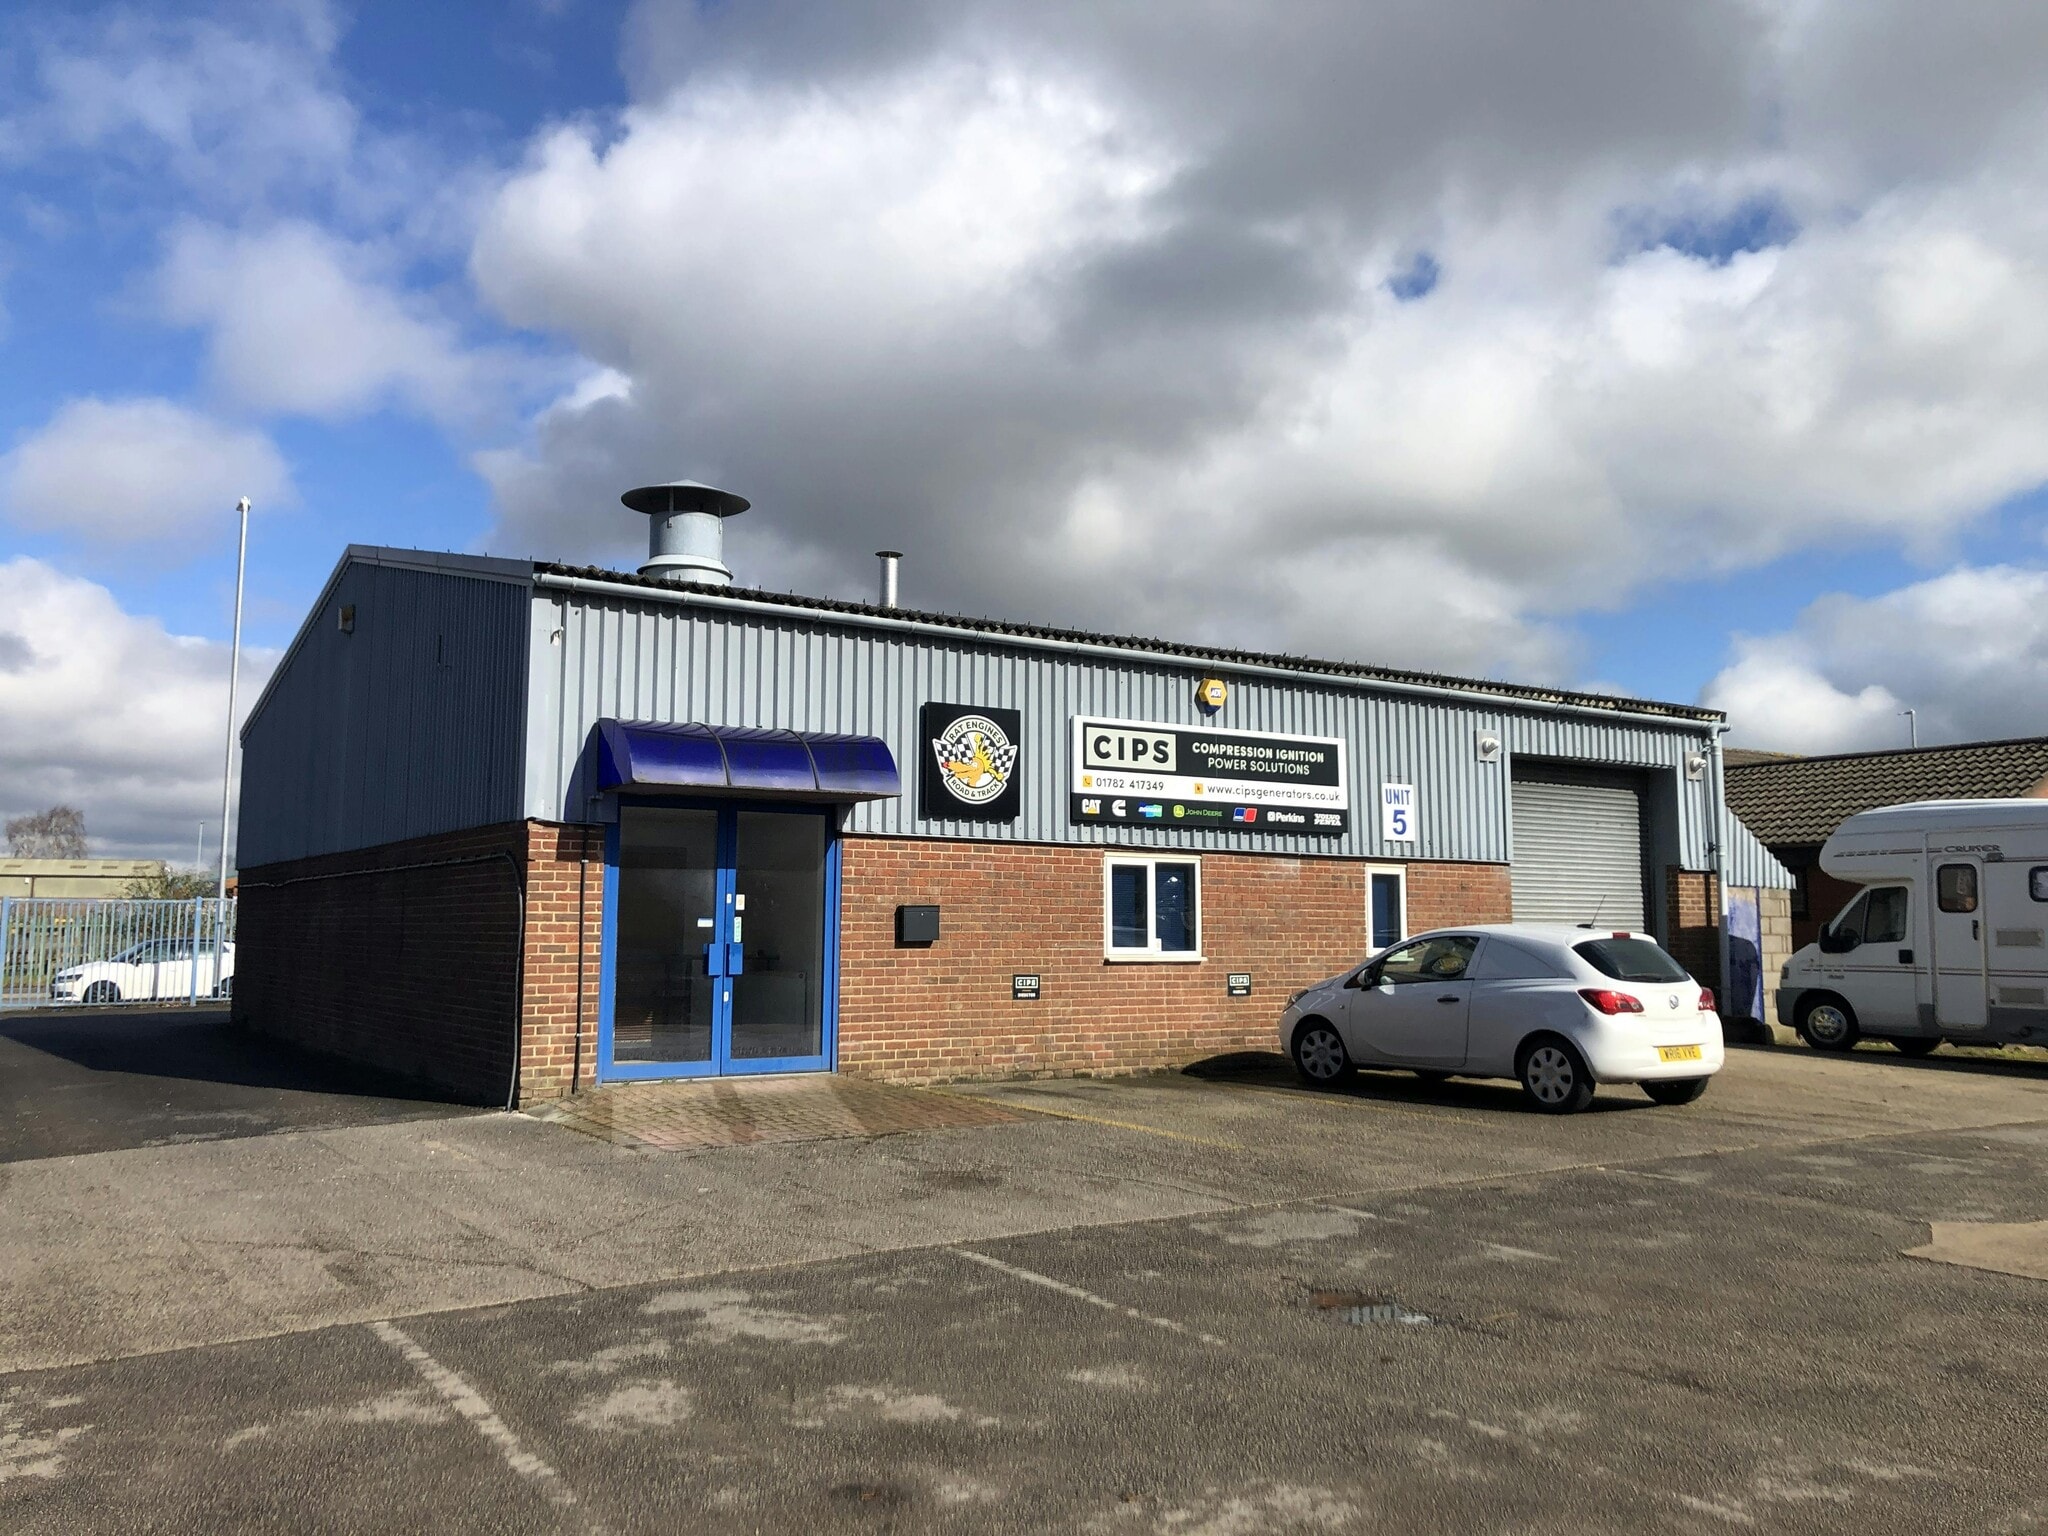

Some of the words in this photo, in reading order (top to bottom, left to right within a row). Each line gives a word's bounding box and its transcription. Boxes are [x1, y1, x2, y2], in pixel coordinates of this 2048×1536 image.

[949, 725, 965, 740] RAT
[966, 721, 1003, 744] ENGINES
[1093, 735, 1169, 763] CIPS
[1192, 742, 1273, 759] COMPRESSION
[1276, 749, 1324, 763] IGNITION
[1208, 757, 1247, 771] POWER
[1250, 761, 1310, 775] SOLUTIONS
[951, 779, 970, 796] ROAD
[977, 782, 999, 797] TRACK
[1096, 777, 1125, 788] 01782
[1129, 780, 1164, 791] 417349
[1207, 784, 1340, 801] www.cipsgenerators.co.uk
[1385, 788, 1410, 805] UNIT
[1081, 799, 1101, 814] CAT
[1185, 808, 1202, 816] JOHN
[1203, 809, 1223, 817] DEERE
[1275, 811, 1305, 823] Perkins
[1392, 809, 1407, 835] 5
